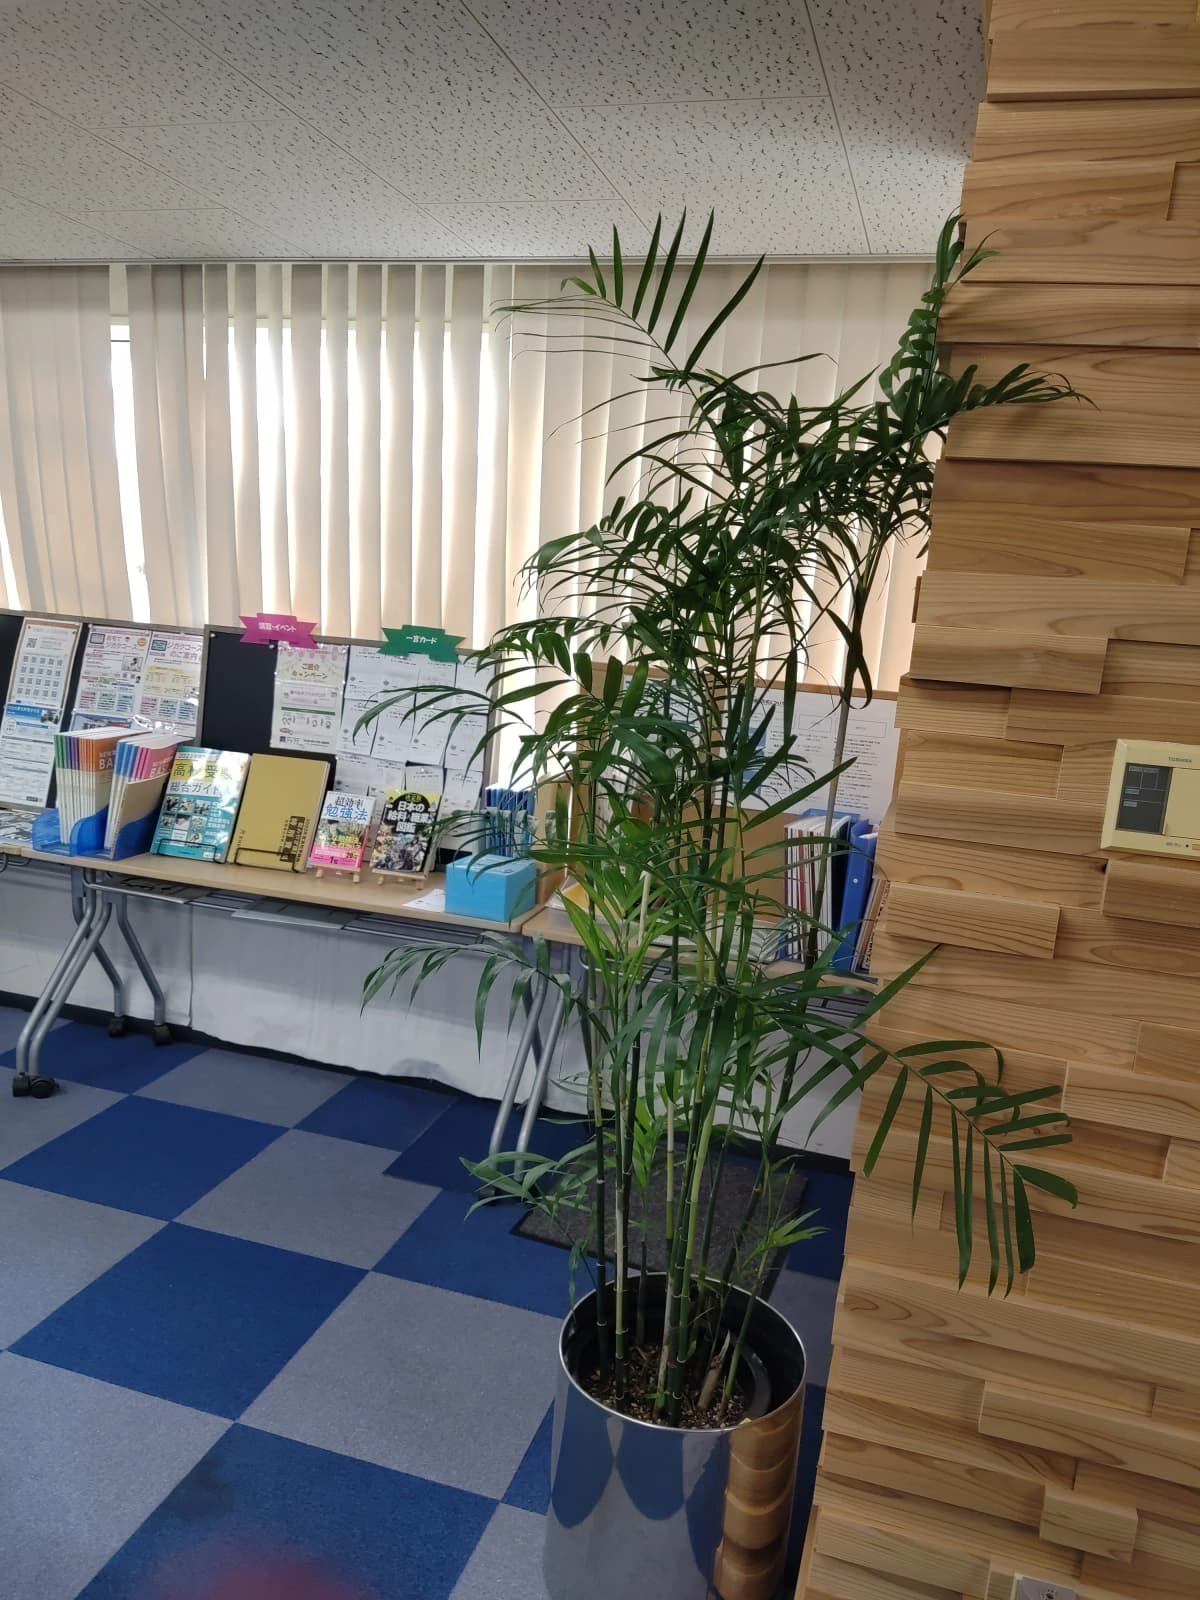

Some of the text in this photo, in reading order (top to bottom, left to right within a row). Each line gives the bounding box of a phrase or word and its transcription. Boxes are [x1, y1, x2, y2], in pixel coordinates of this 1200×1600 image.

[405, 634, 438, 645] 一言カード
[326, 803, 368, 820] 勉強法
[397, 801, 425, 813] 日本の
